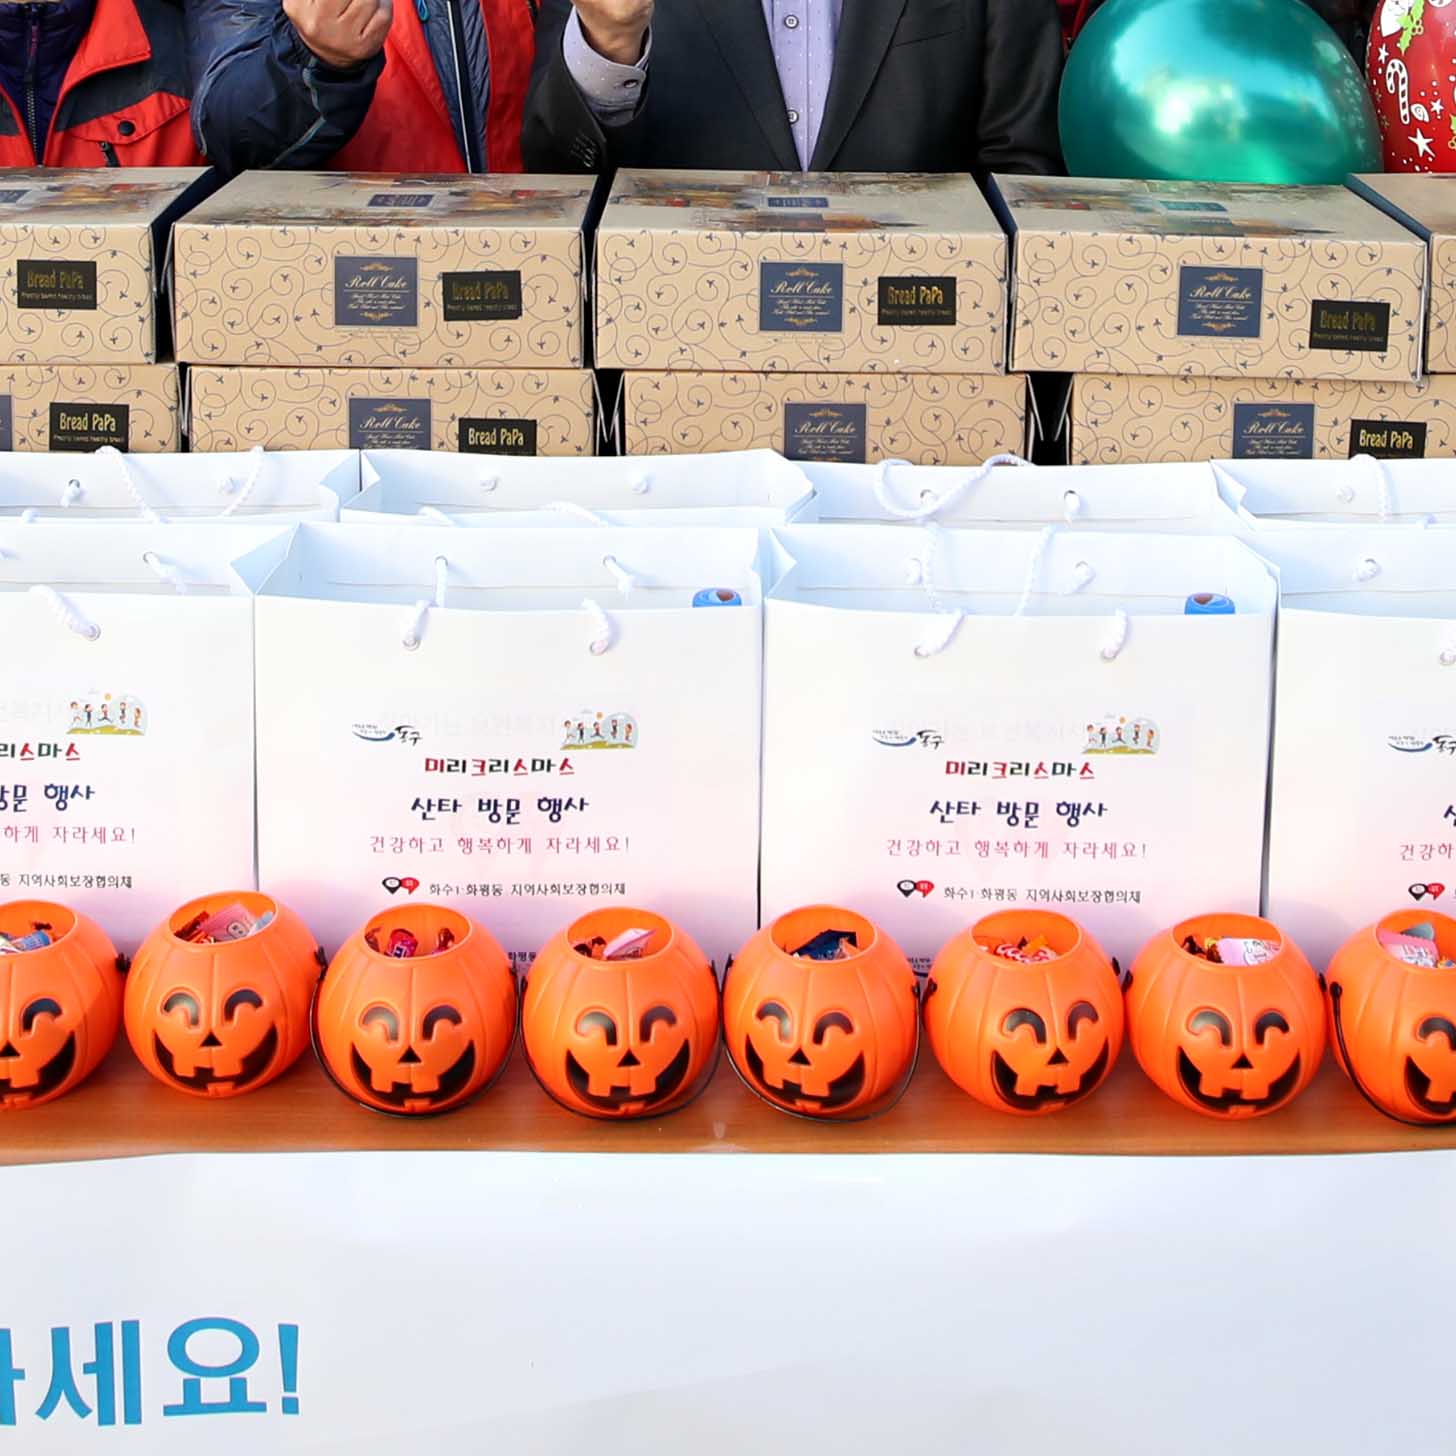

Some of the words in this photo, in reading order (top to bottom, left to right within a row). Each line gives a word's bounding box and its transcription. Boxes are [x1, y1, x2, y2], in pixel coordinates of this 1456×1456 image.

[345, 275, 378, 288] Roll
[379, 275, 407, 288] Cake
[771, 280, 804, 294] Roll
[805, 282, 832, 294] Cake
[1190, 286, 1223, 298] Roll
[1224, 286, 1252, 298] Cake
[60, 413, 88, 431] Bread
[92, 414, 116, 432] PaPa
[360, 416, 392, 429] Roll
[393, 417, 422, 429] Cake
[795, 420, 828, 433] Roll
[829, 421, 857, 433] Cake
[1244, 420, 1276, 433] Roll
[1277, 422, 1304, 433] Cake
[468, 428, 496, 445] Bread
[500, 428, 524, 446] PaPa
[1360, 430, 1388, 448] Bread
[1391, 431, 1413, 448] PaPa
[425, 757, 575, 776] 미리크리스마스
[945, 760, 1095, 779] 미리크리스마스
[44, 783, 95, 811] 행사
[411, 797, 462, 820] 산타
[478, 798, 521, 825] 방문
[537, 796, 589, 823] 행사
[930, 801, 981, 824] 산타
[997, 801, 1040, 829] 방문
[1056, 801, 1108, 828] 행사
[52, 826, 136, 844] 자라세요!
[370, 836, 444, 854] 건강하고
[457, 837, 532, 855] 행복하게
[546, 837, 630, 854] 자라세요!
[887, 839, 961, 857] 건강하고
[974, 841, 1049, 859] 행복하게
[1064, 843, 1147, 859] 자라세요!
[19, 874, 132, 889] 지역사회보장협의체
[511, 884, 626, 896] 지역사회보장협의체
[1026, 890, 1141, 904] 지역사회보장협의체
